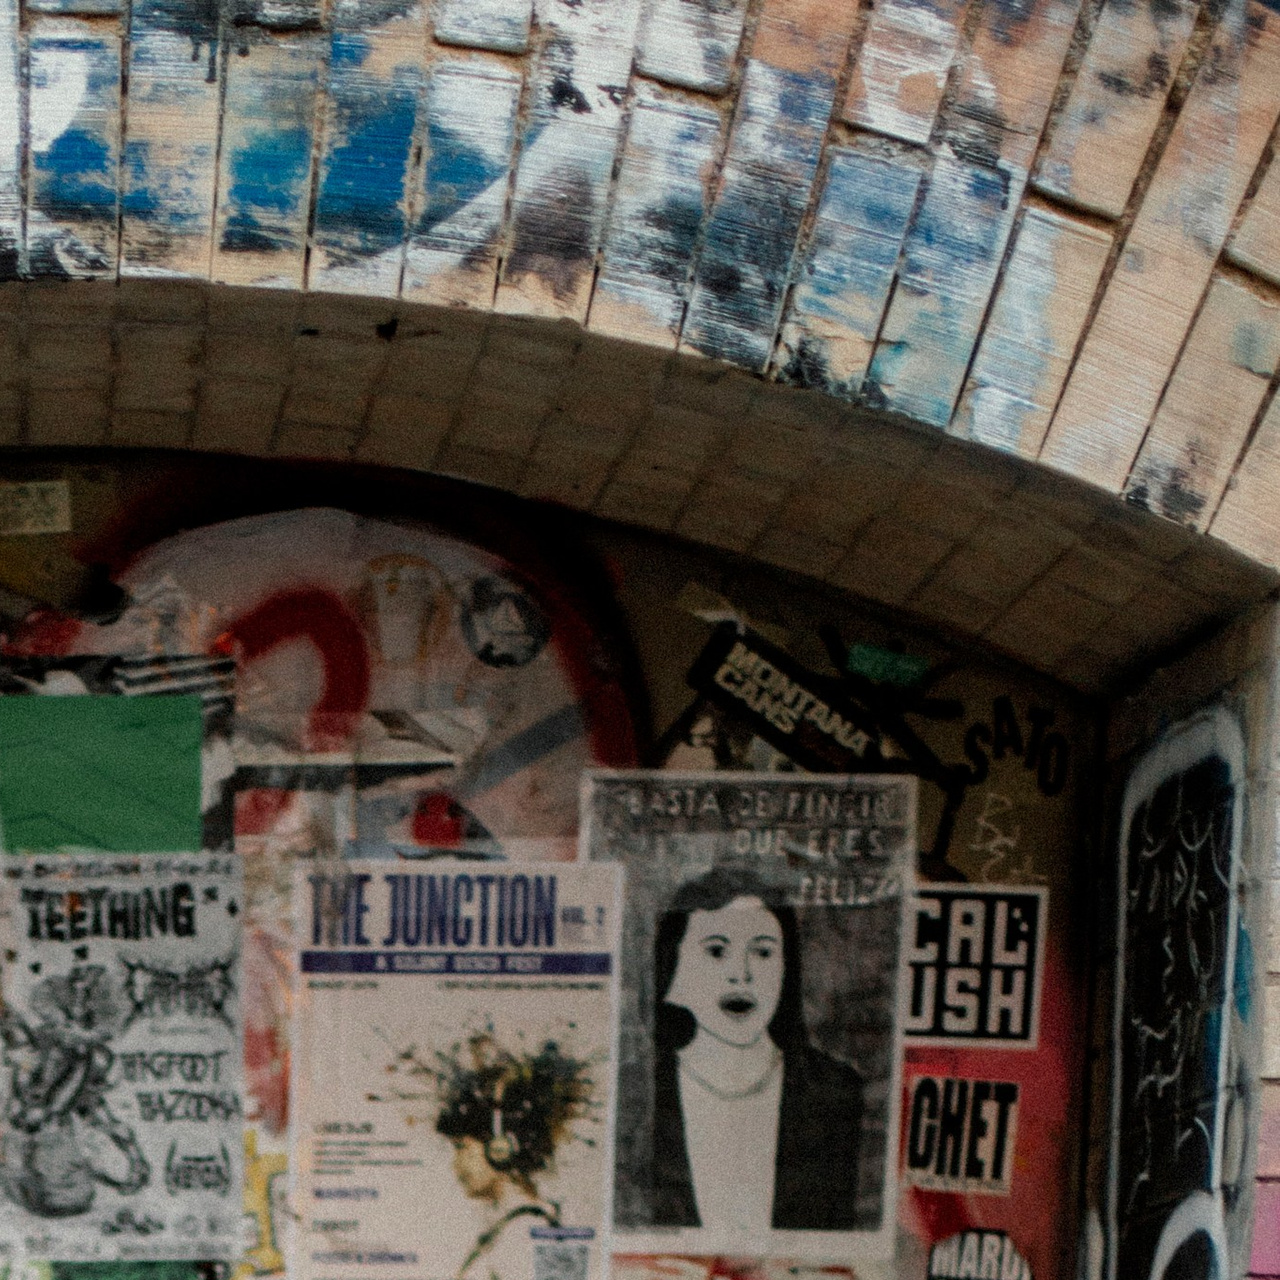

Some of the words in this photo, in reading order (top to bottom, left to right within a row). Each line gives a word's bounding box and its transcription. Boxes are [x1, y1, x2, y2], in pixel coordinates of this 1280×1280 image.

[713, 663, 803, 735] CANS
[722, 641, 876, 760] MONTANA
[21, 882, 198, 941] TEETHING
[382, 873, 558, 948] JUNCTION
